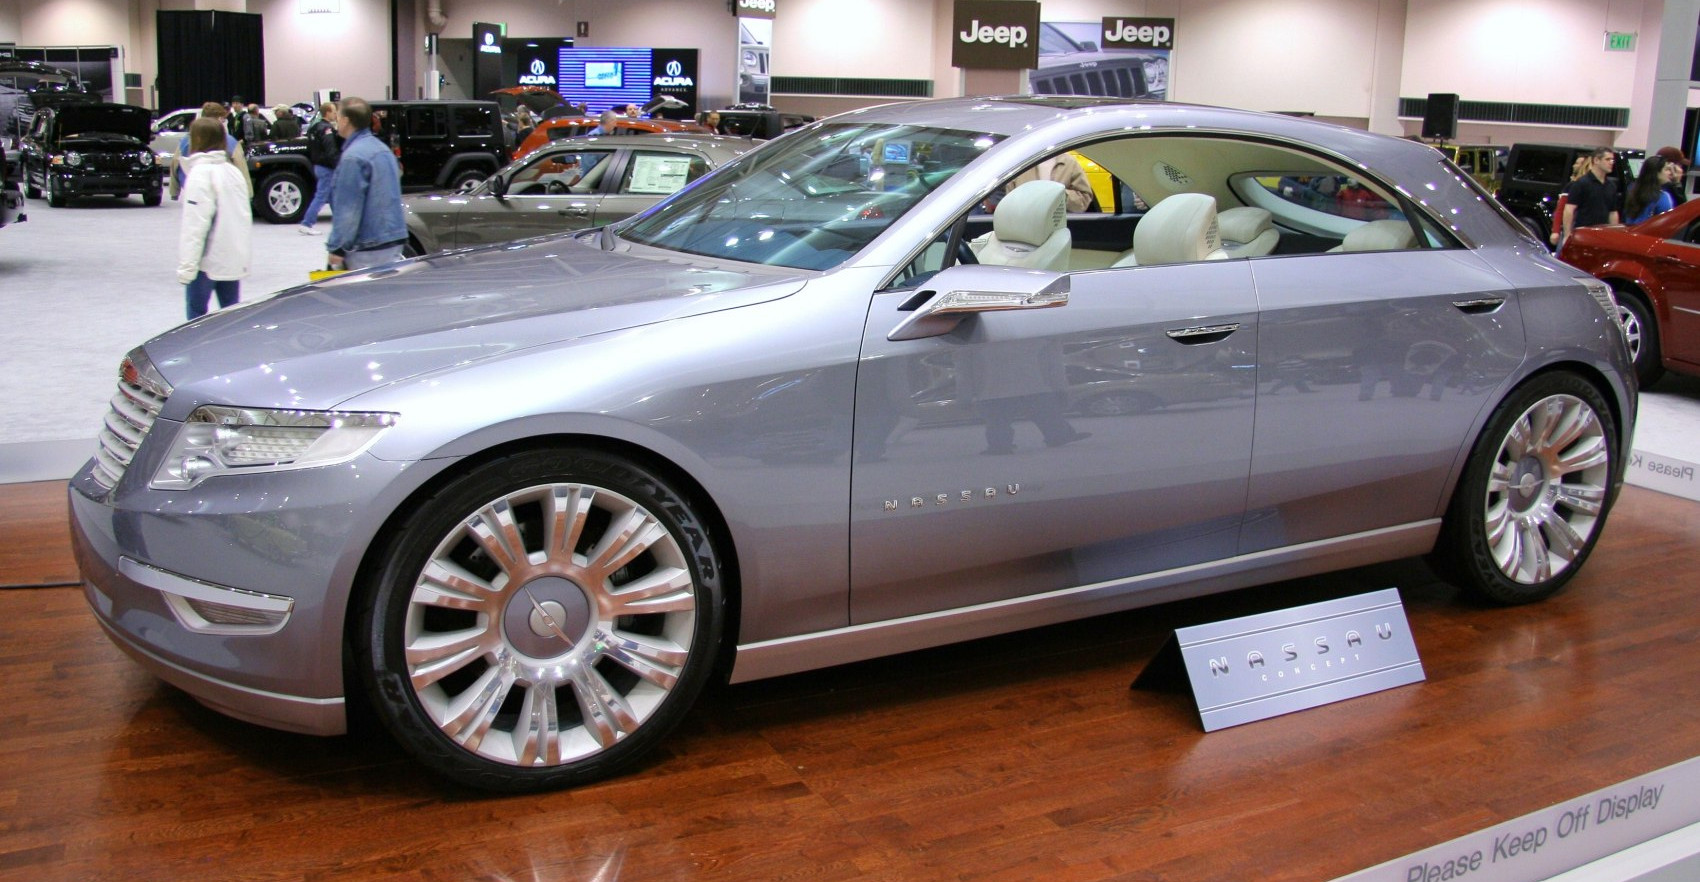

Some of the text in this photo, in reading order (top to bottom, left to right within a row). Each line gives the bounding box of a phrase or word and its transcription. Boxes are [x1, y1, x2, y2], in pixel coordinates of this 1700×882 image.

[960, 20, 1028, 48] Jeep
[1105, 20, 1171, 47] Jeep
[1610, 35, 1632, 48] EXIT
[519, 75, 556, 84] ACURA
[653, 77, 693, 86] ACURA
[884, 483, 1020, 512] NASSAU
[1209, 622, 1392, 677] NASSAU
[1261, 653, 1360, 682] CONCEPT
[1407, 784, 1665, 882] Please Keep Off Display
